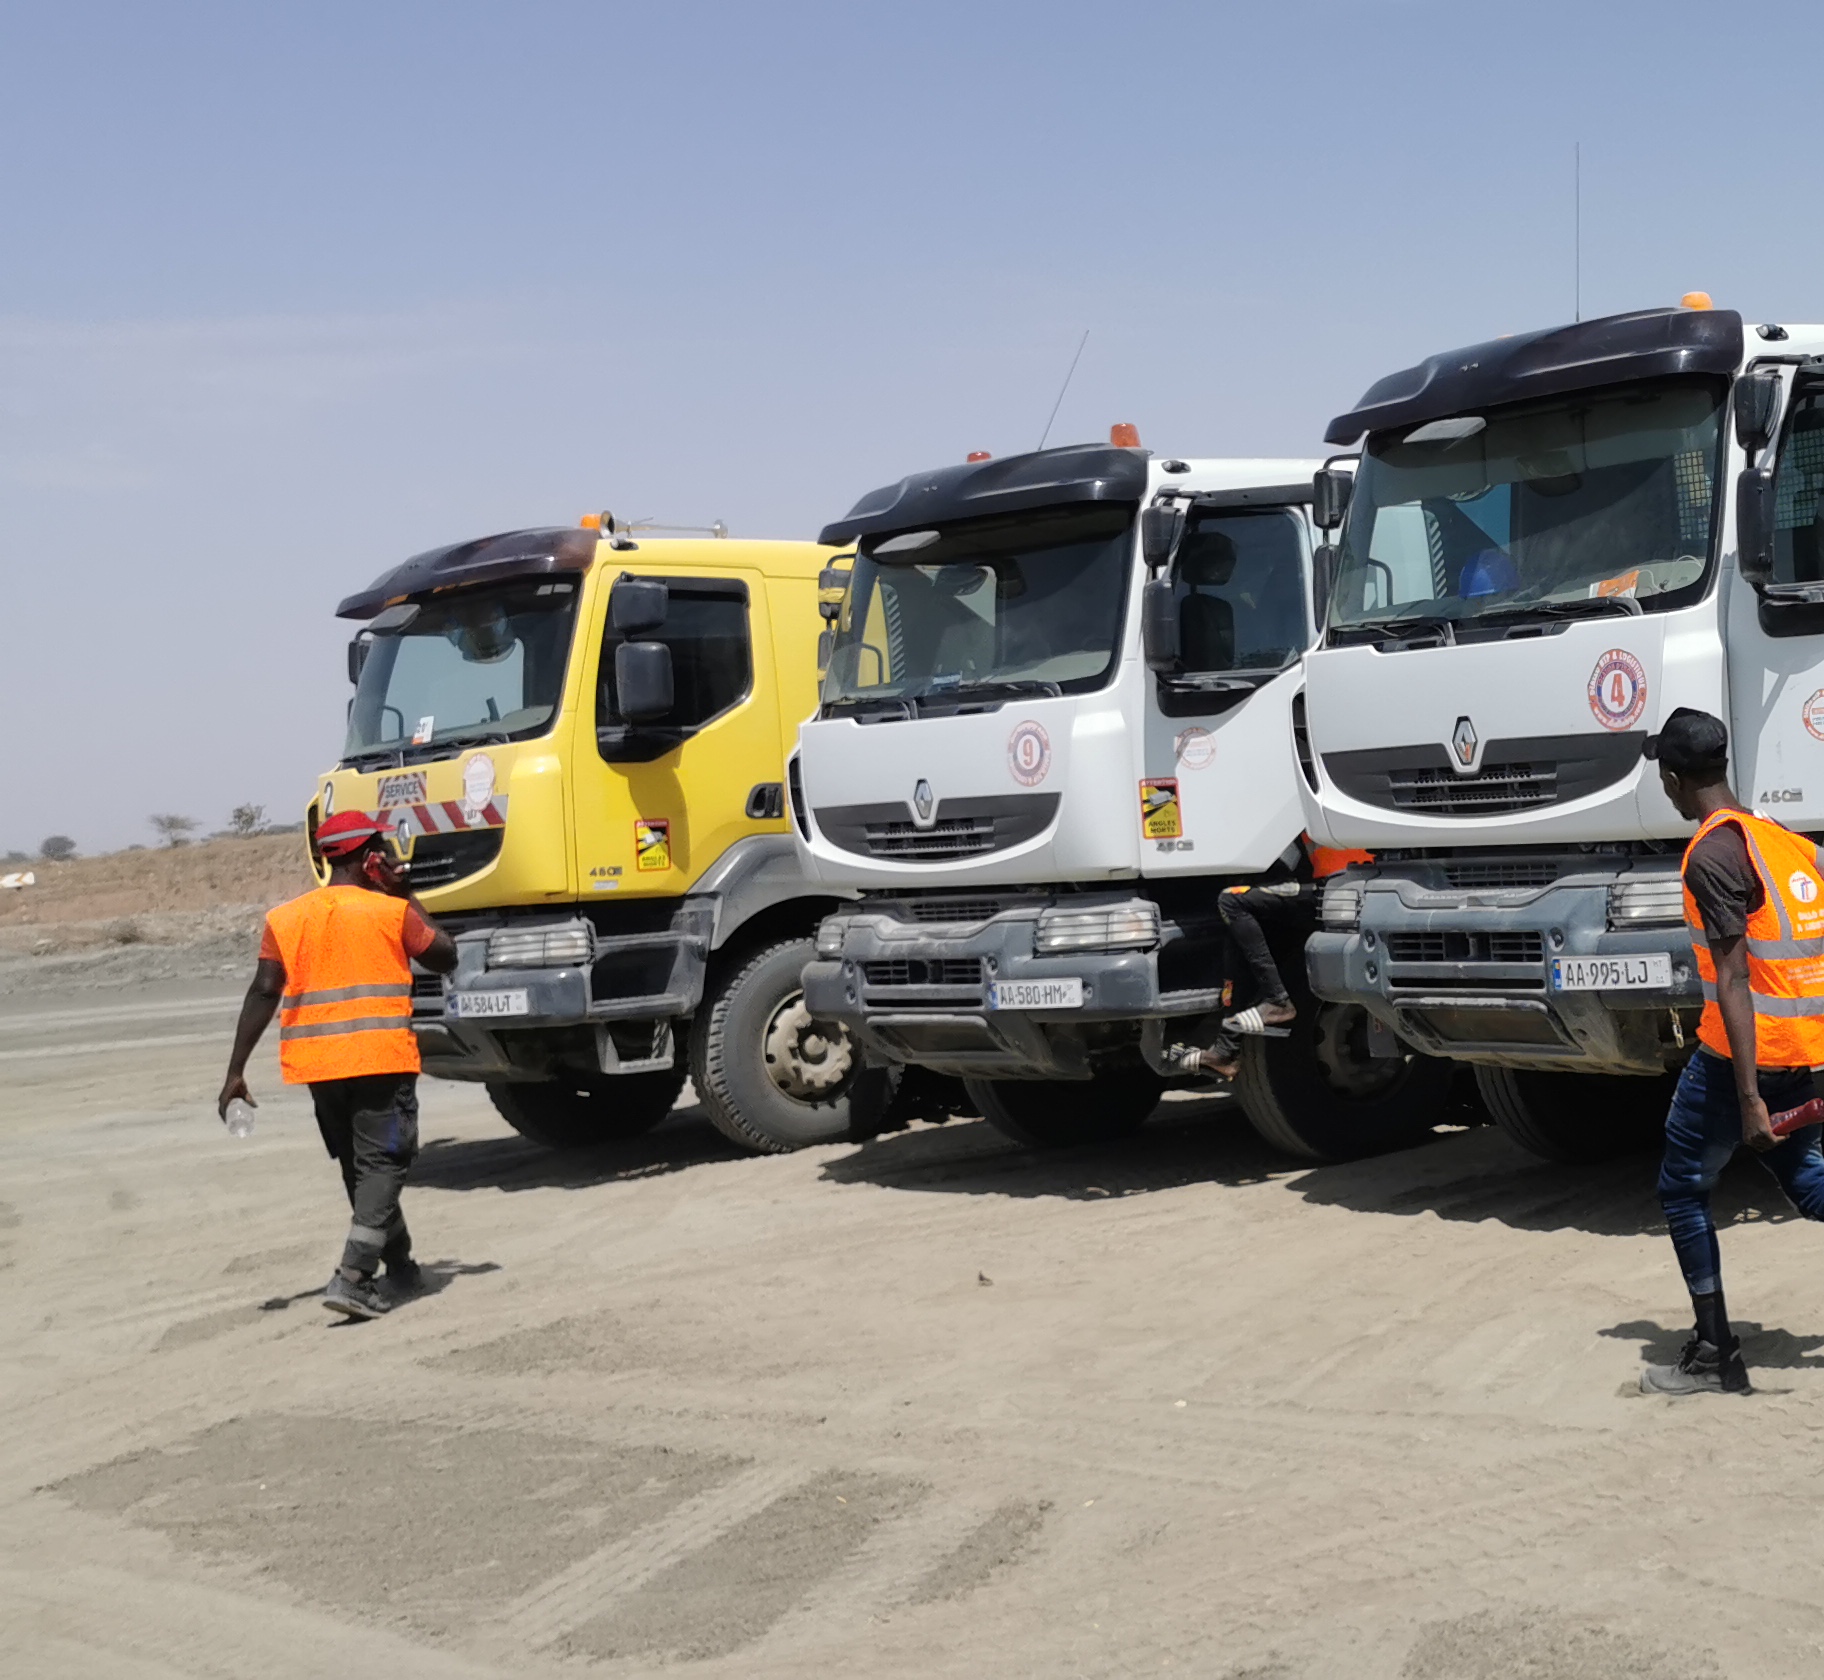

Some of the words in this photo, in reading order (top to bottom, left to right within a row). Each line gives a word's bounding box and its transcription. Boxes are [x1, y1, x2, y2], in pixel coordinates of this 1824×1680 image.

[1611, 673, 1625, 707] 4
[1023, 738, 1034, 767] 9
[385, 780, 418, 799] SERVICE
